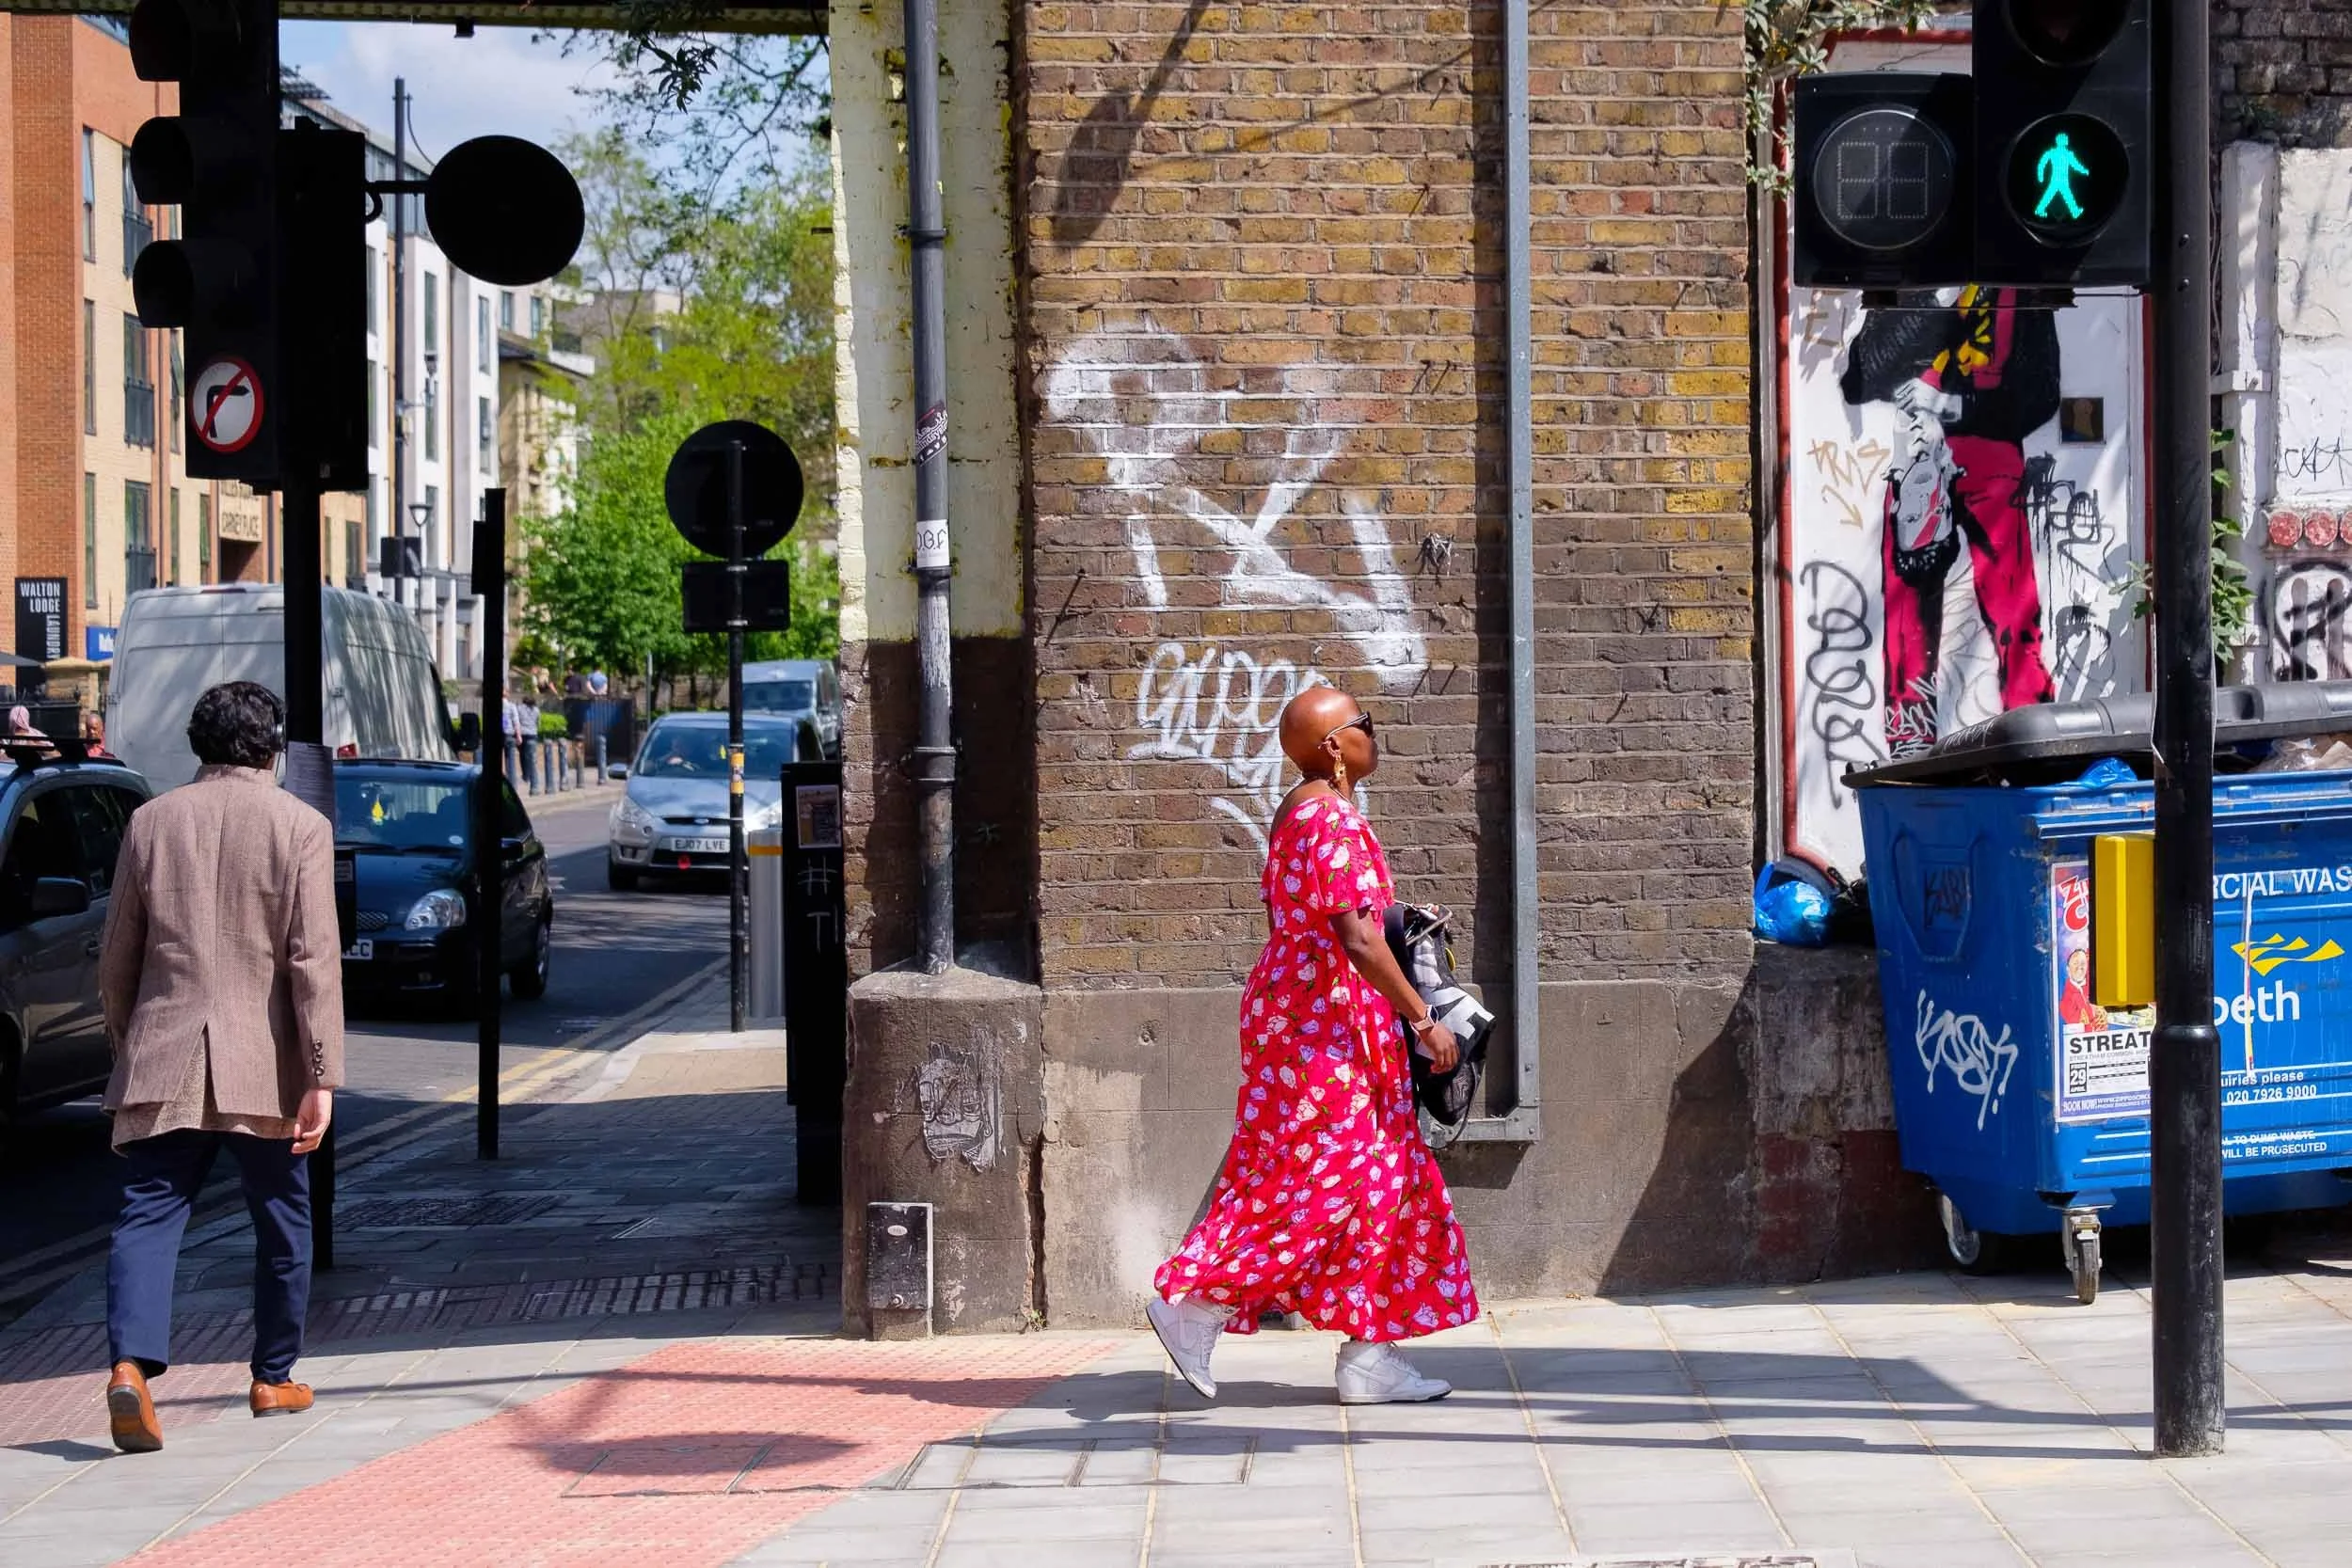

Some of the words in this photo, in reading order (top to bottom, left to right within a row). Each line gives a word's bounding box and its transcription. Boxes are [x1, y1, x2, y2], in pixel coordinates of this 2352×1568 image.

[20, 581, 60, 596] WALTON
[30, 597, 60, 612] LODGE
[46, 614, 60, 659] LAUNDRY
[2071, 1069, 2086, 1085] 29
[2262, 1071, 2304, 1085] please
[2227, 1090, 2249, 1103] 020
[2253, 1087, 2282, 1101] 7926
[2286, 1085, 2317, 1099] 9000
[2233, 1135, 2247, 1145] TO
[2249, 1132, 2278, 1143] DUMP
[2280, 1131, 2316, 1141] WASTE
[2246, 1147, 2260, 1157] BE
[2261, 1142, 2328, 1156] PROSECUTED
